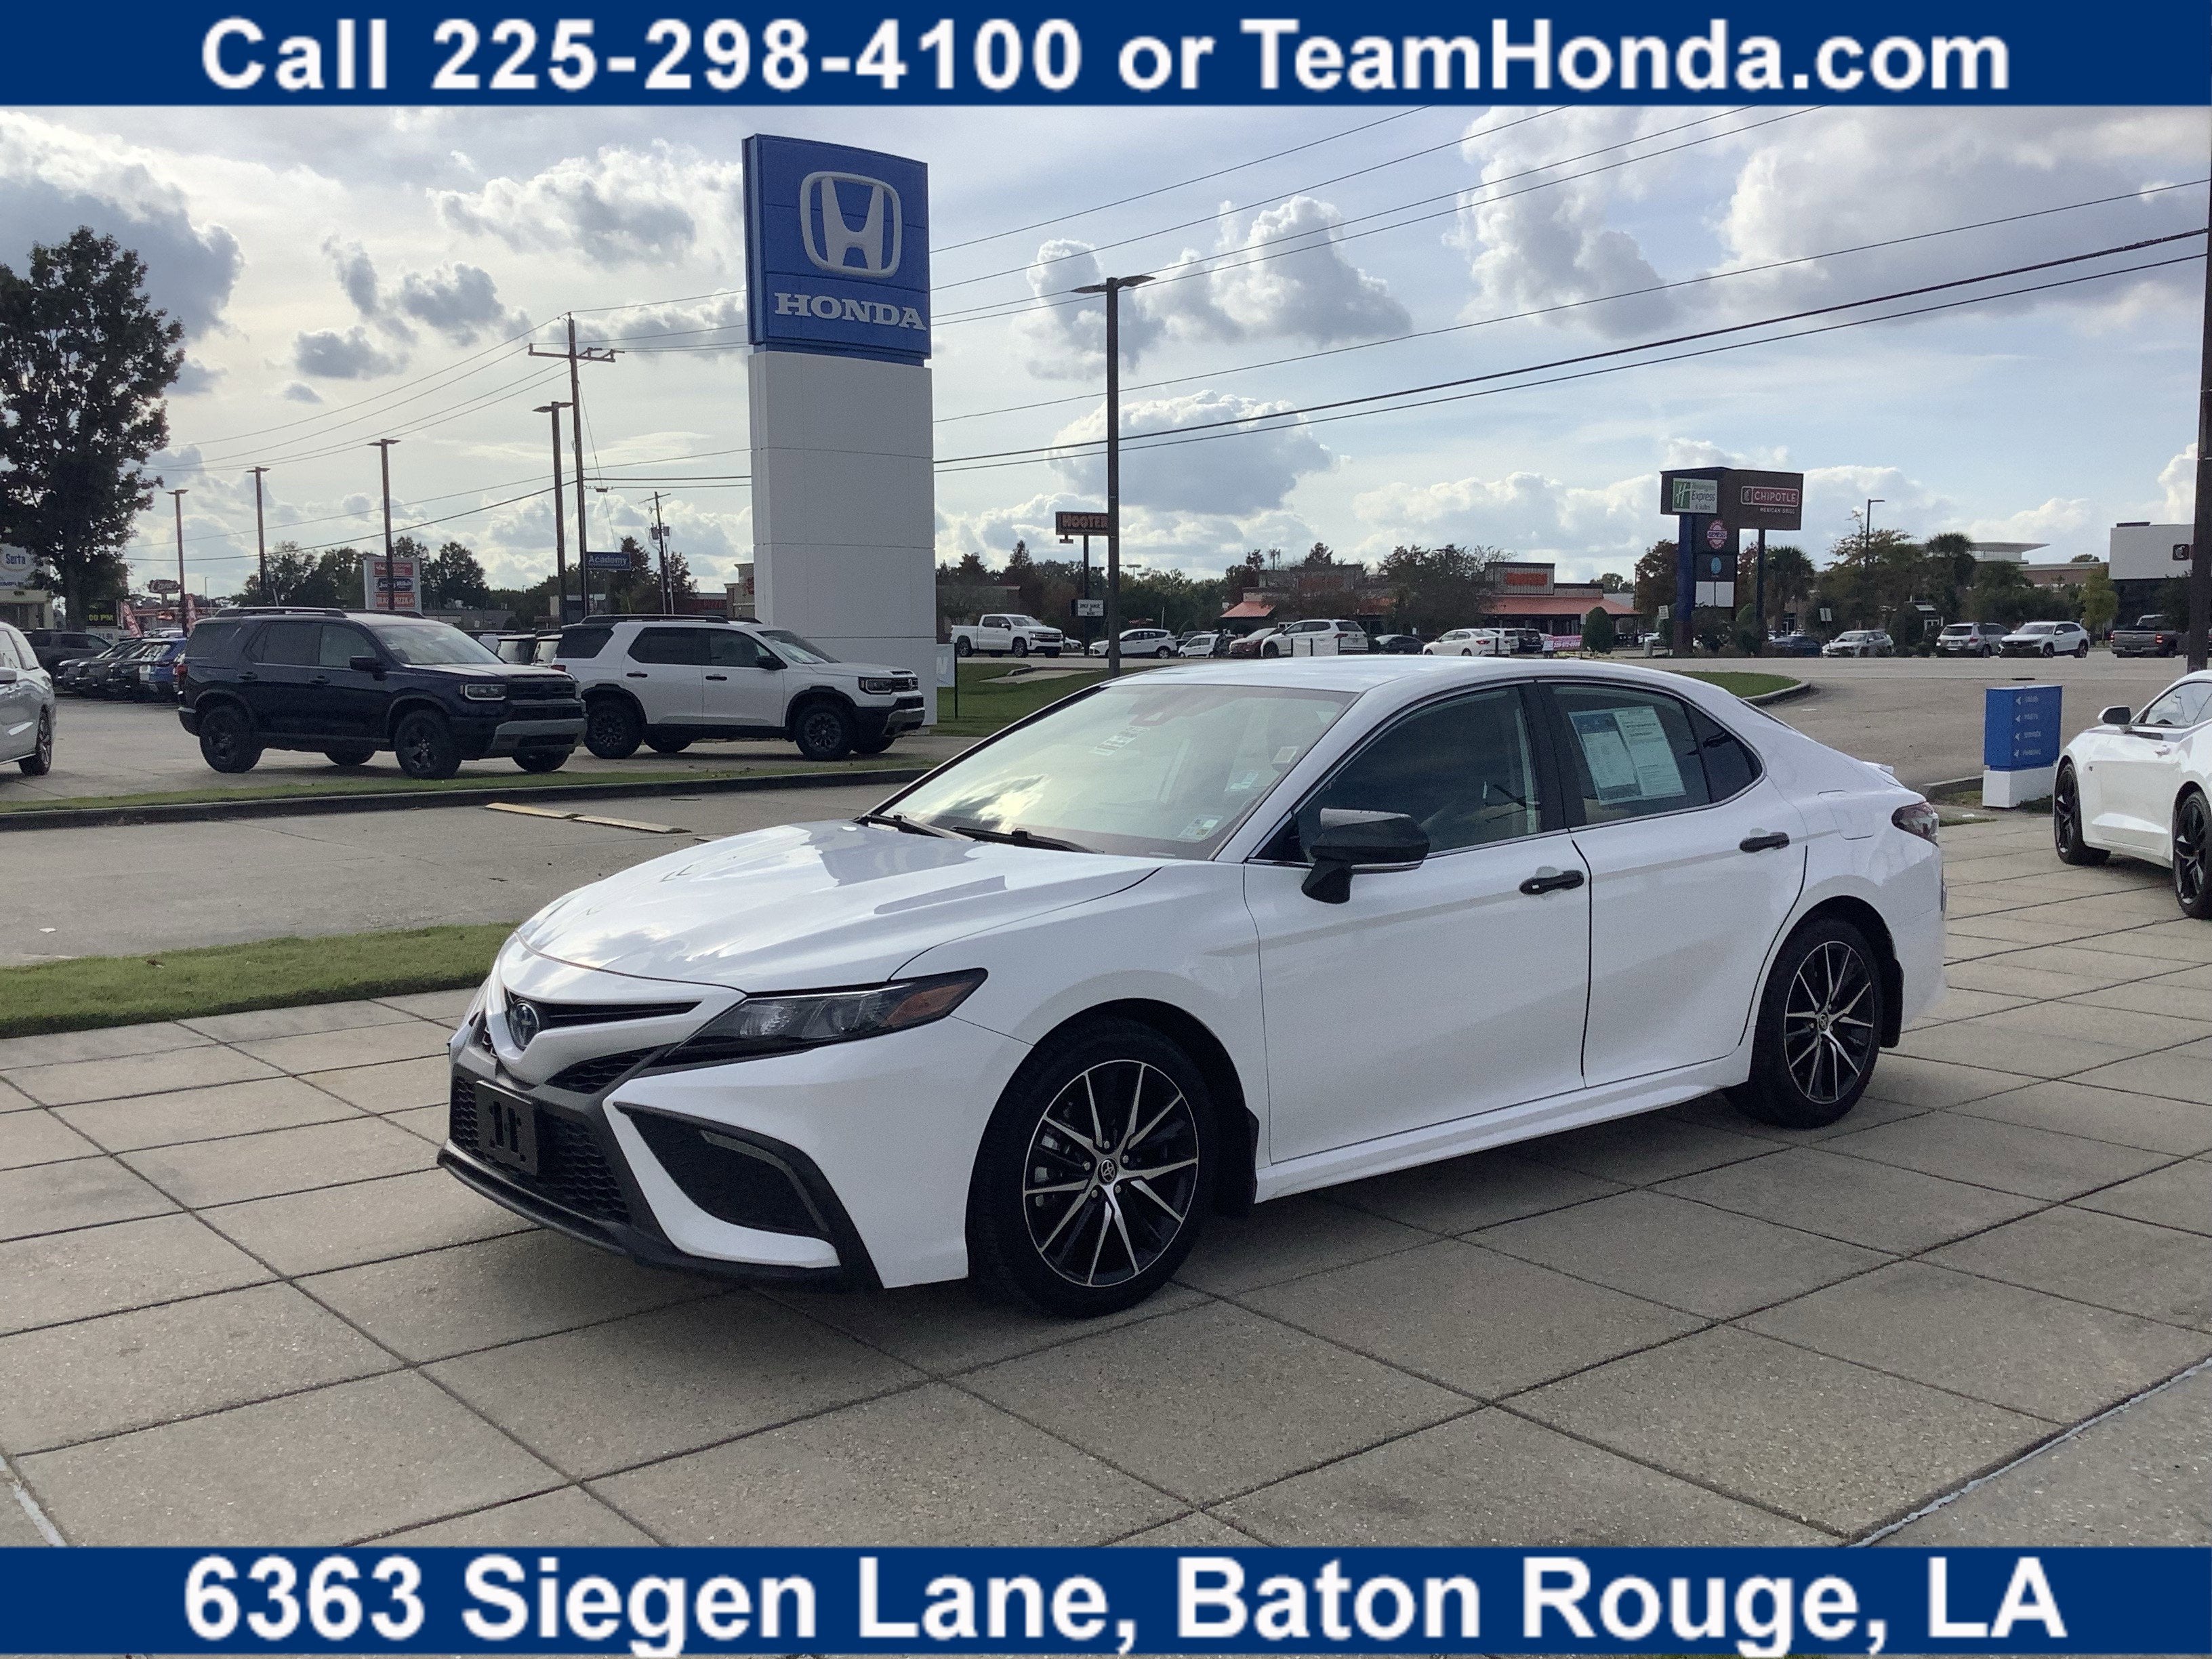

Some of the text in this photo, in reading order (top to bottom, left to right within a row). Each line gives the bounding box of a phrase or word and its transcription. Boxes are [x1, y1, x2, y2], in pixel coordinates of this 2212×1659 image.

[773, 292, 926, 331] HONDA
[1692, 491, 1715, 502] Express
[1754, 490, 1797, 503] CHIPOTLE
[1062, 514, 1108, 528] HOOTER
[5, 554, 26, 565] Serta
[589, 555, 628, 566] Academy
